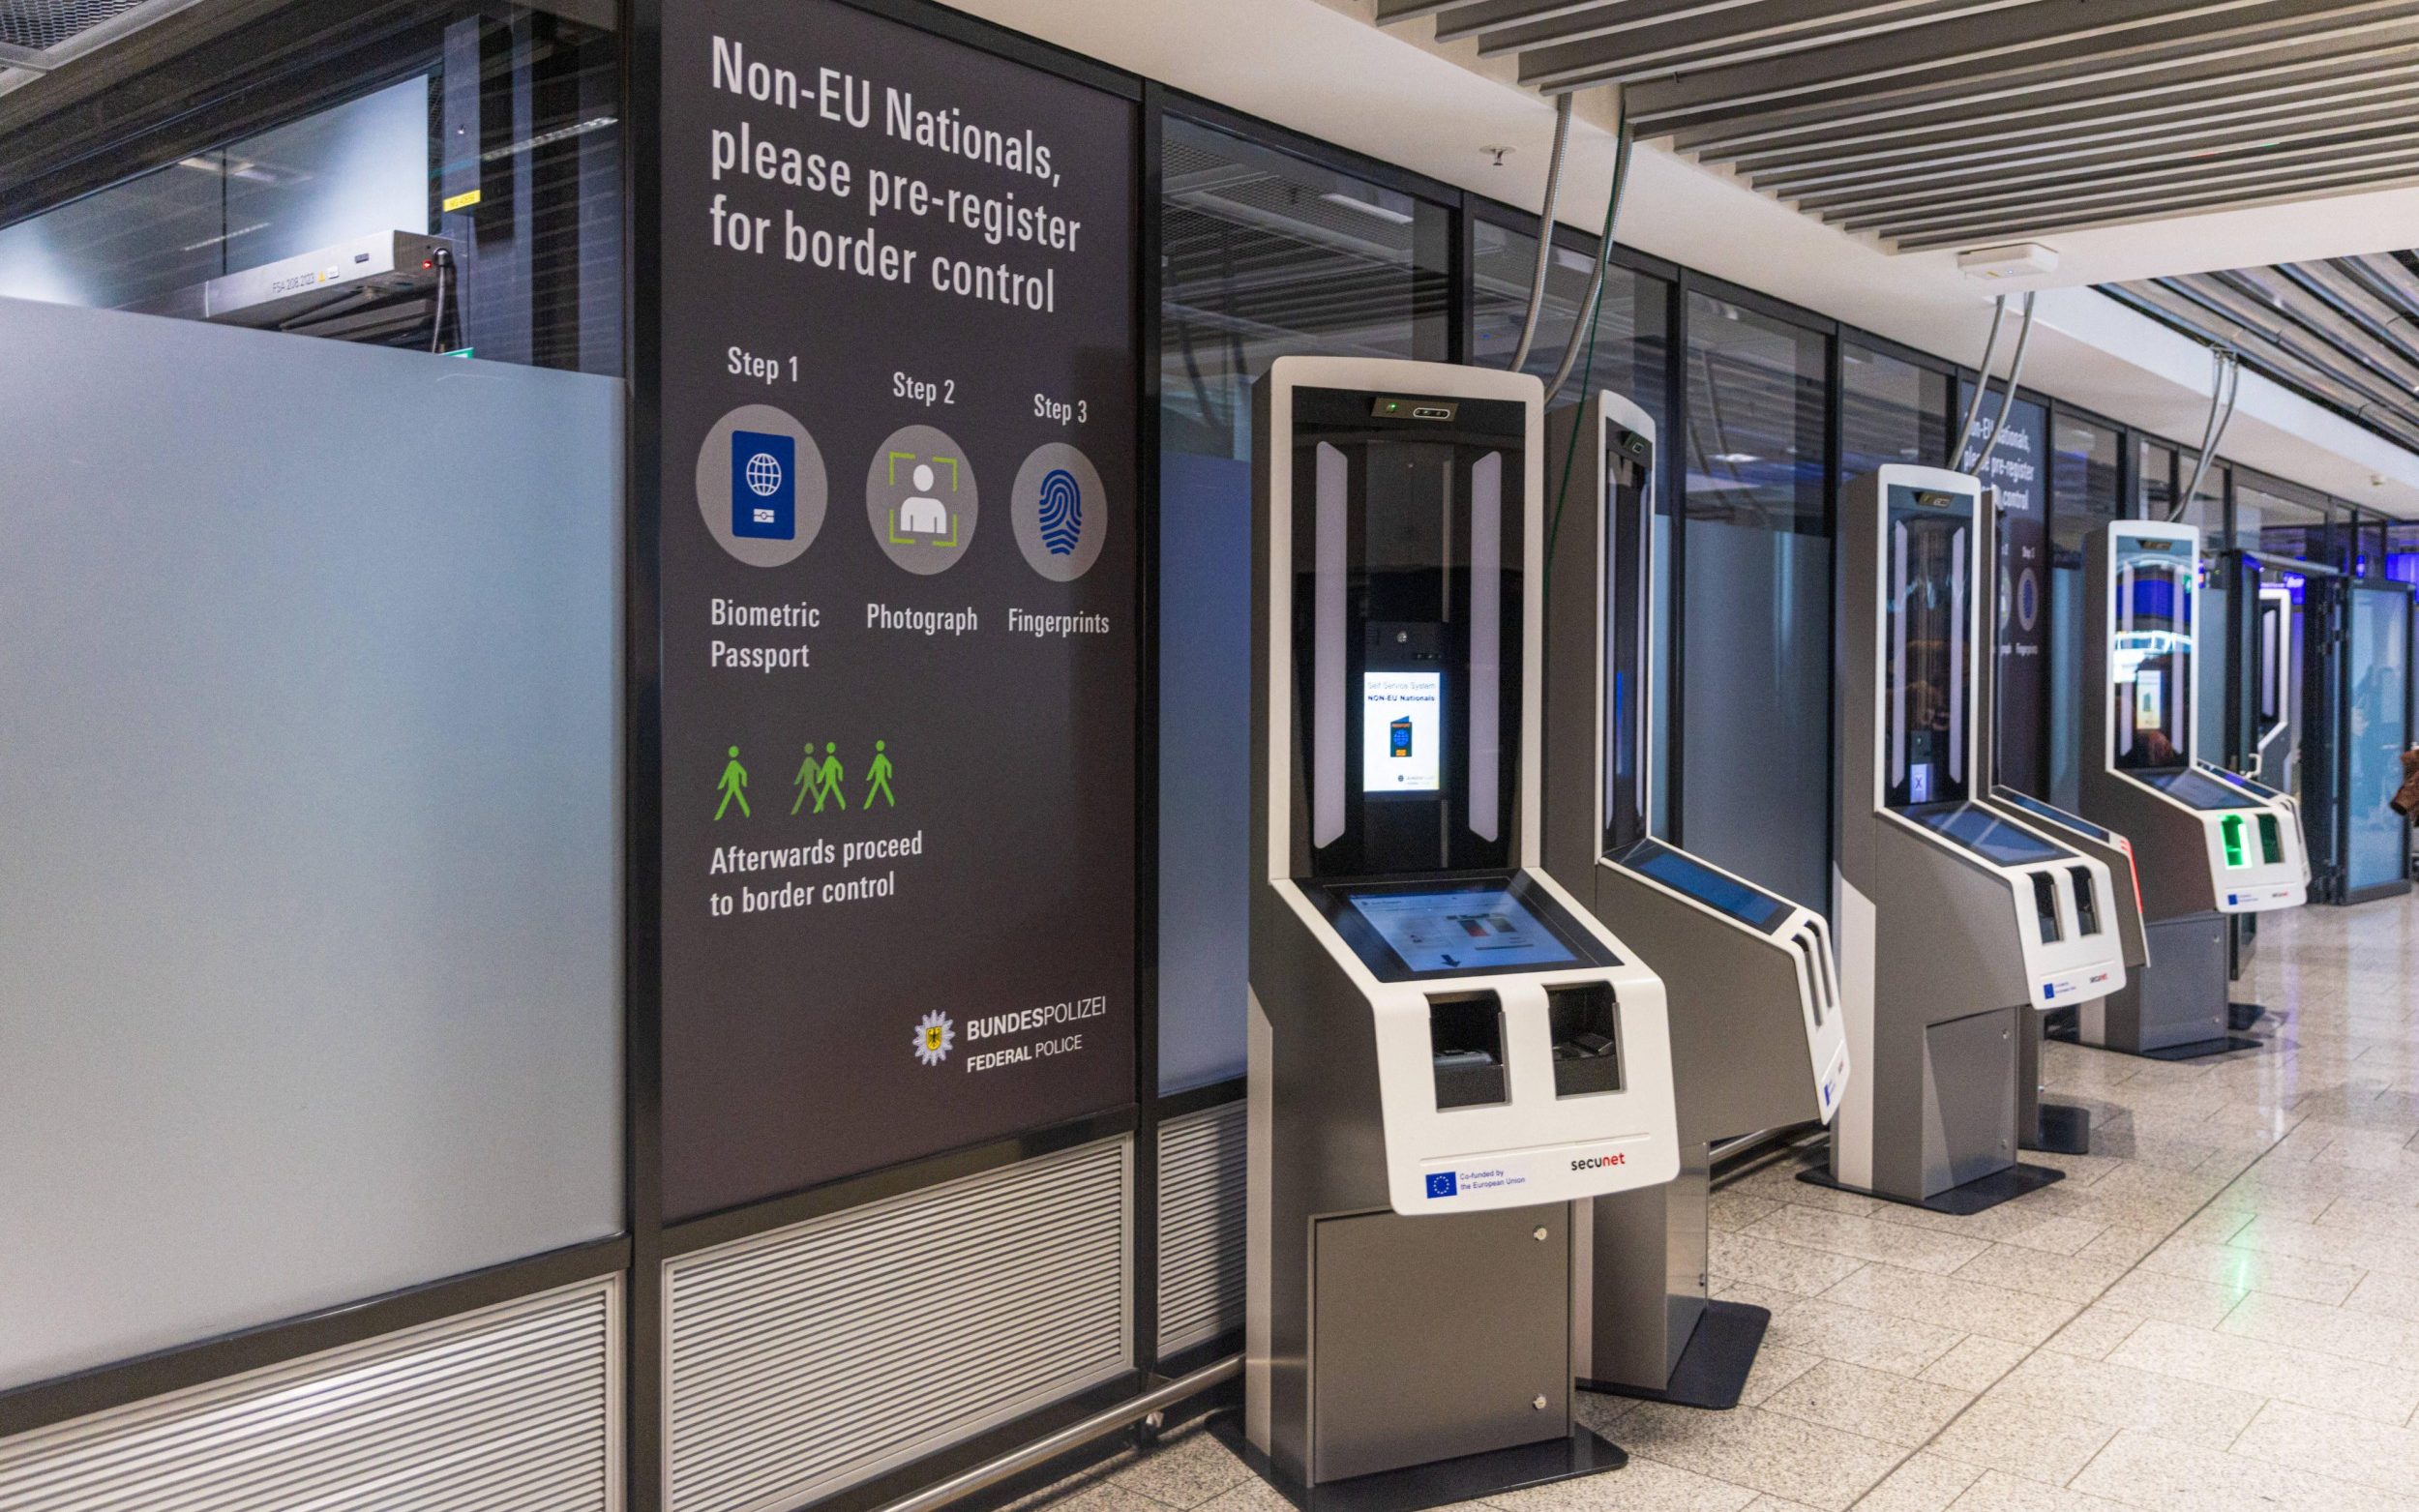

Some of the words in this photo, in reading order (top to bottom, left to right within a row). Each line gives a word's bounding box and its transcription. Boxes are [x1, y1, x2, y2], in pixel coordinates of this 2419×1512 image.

[712, 35, 870, 129] Non-EU
[886, 87, 1060, 188] Nationals,
[712, 122, 851, 197] please
[869, 168, 1081, 252] pre-register
[709, 194, 771, 254] for
[785, 210, 916, 284] border
[932, 256, 1054, 312] control
[728, 346, 779, 385] Step
[789, 356, 798, 382] 1
[893, 371, 937, 406] Step
[943, 379, 955, 404] 2
[1033, 394, 1072, 426] Step
[1077, 400, 1088, 424] 3
[711, 598, 820, 628] Biometric
[867, 604, 978, 636] Photograph
[1008, 608, 1110, 637] Fingerprints
[711, 640, 810, 673] Passport
[710, 839, 835, 875] Afterwards
[843, 830, 923, 868] proceed
[710, 891, 733, 917] to
[742, 882, 815, 913] border
[822, 871, 895, 904] control
[967, 995, 1107, 1041] BUNDESPOLIZEI
[967, 1046, 1032, 1073] FEDERAL
[1034, 1034, 1083, 1058] POLICE
[1459, 1170, 1495, 1180] Co-funded
[1496, 1169, 1505, 1177] by
[1570, 1152, 1626, 1171] secunet
[1473, 1179, 1505, 1191] European
[1506, 1176, 1526, 1185] Union
